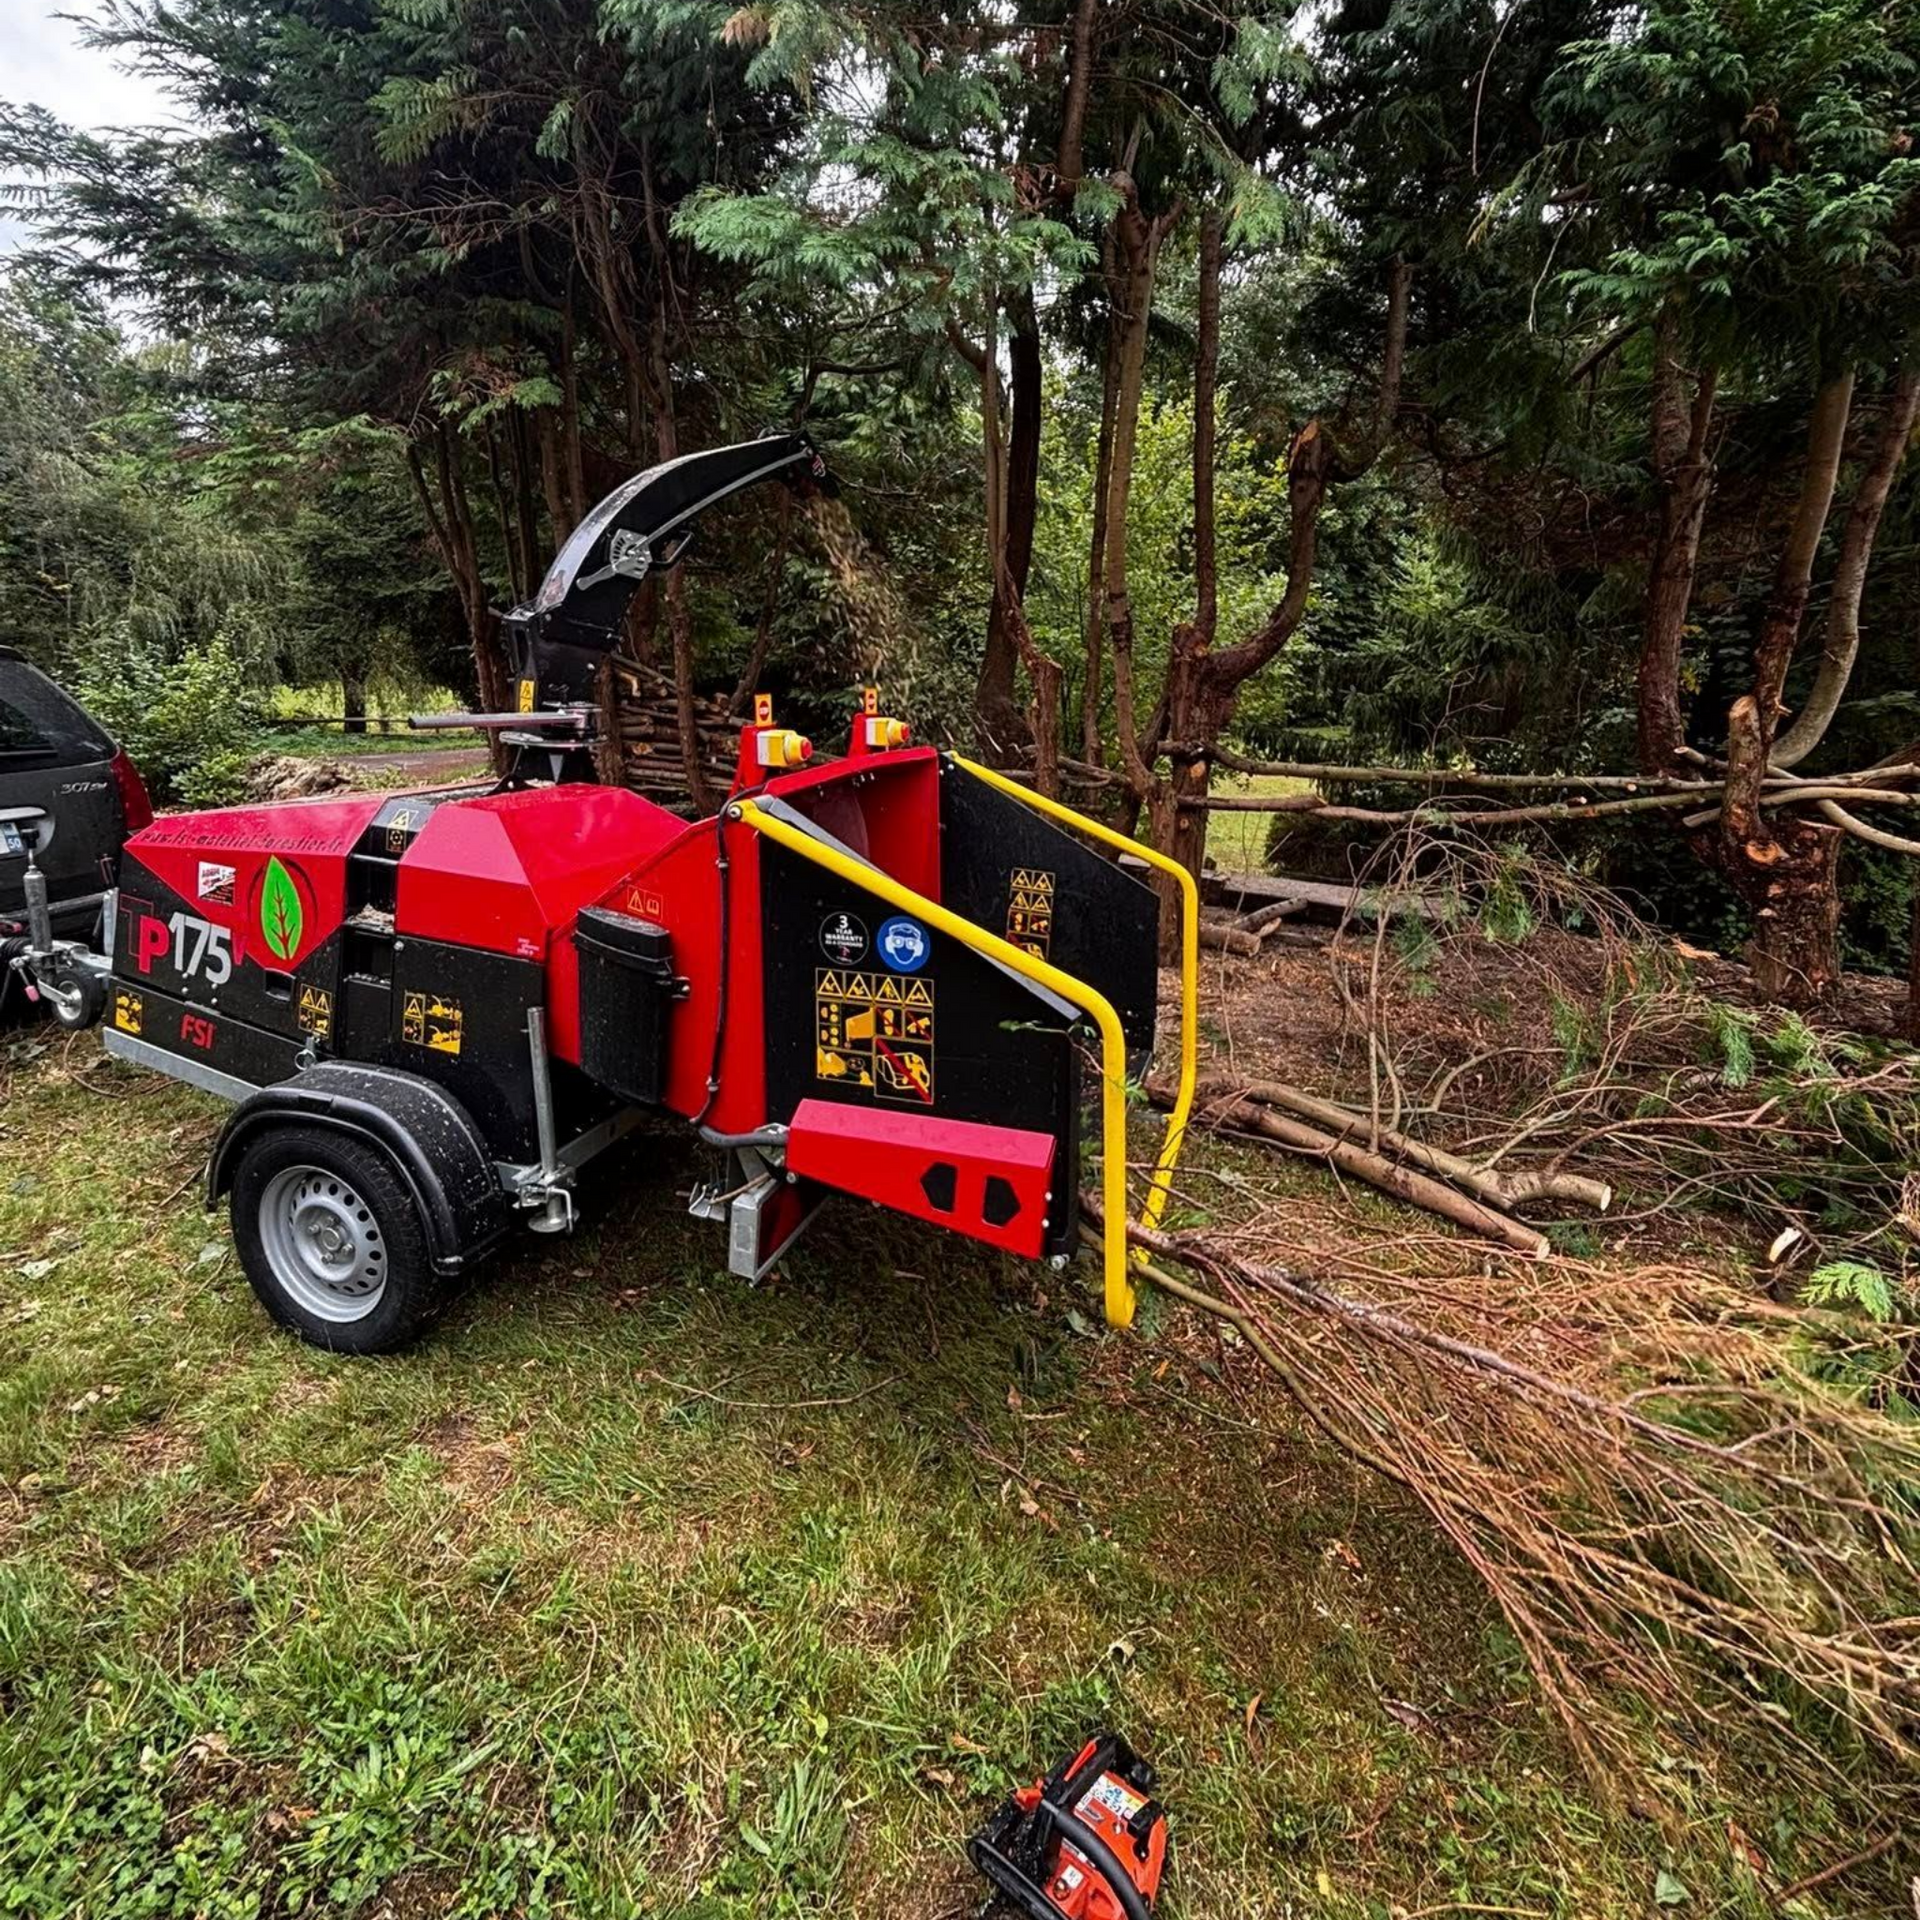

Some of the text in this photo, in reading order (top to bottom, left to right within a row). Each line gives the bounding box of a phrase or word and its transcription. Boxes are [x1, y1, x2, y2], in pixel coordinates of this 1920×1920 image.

[60, 782, 90, 795] 307
[8, 837, 21, 849] 50
[839, 914, 848, 929] 3
[824, 933, 863, 942] WARRANTY
[180, 1013, 216, 1050] FSI
